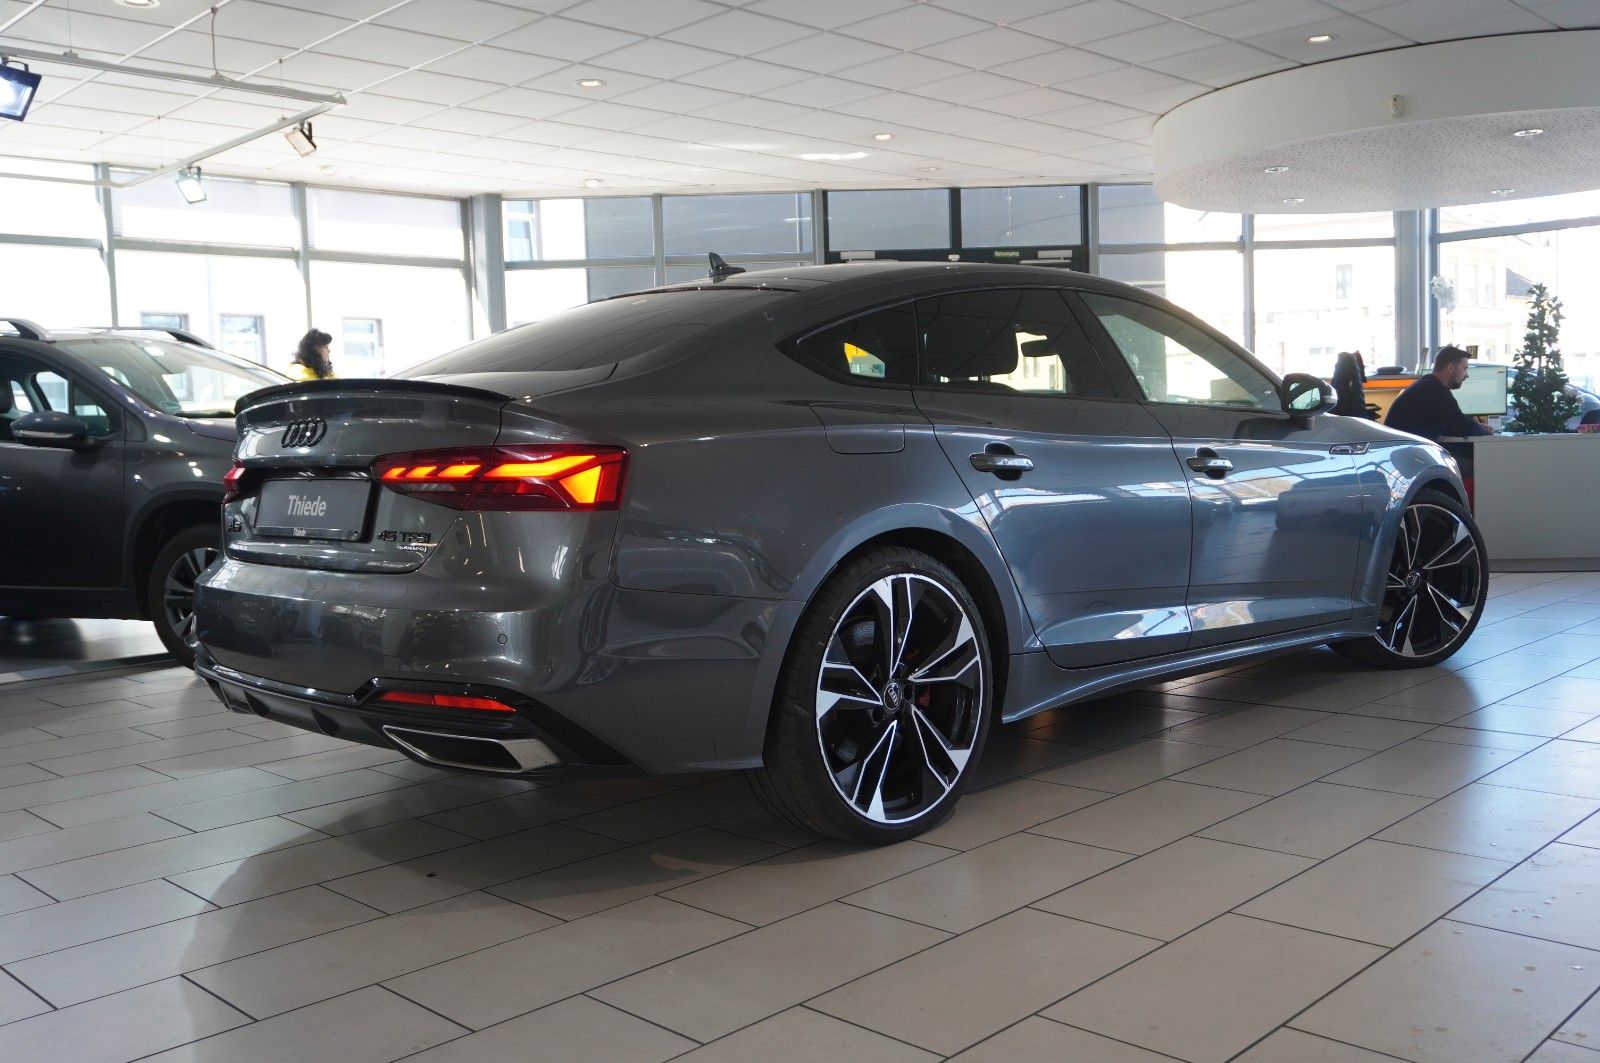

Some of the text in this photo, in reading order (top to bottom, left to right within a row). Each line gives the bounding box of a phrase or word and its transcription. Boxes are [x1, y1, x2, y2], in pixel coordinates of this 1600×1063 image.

[287, 494, 327, 517] Thiede
[377, 529, 431, 543] 45 TFSI
